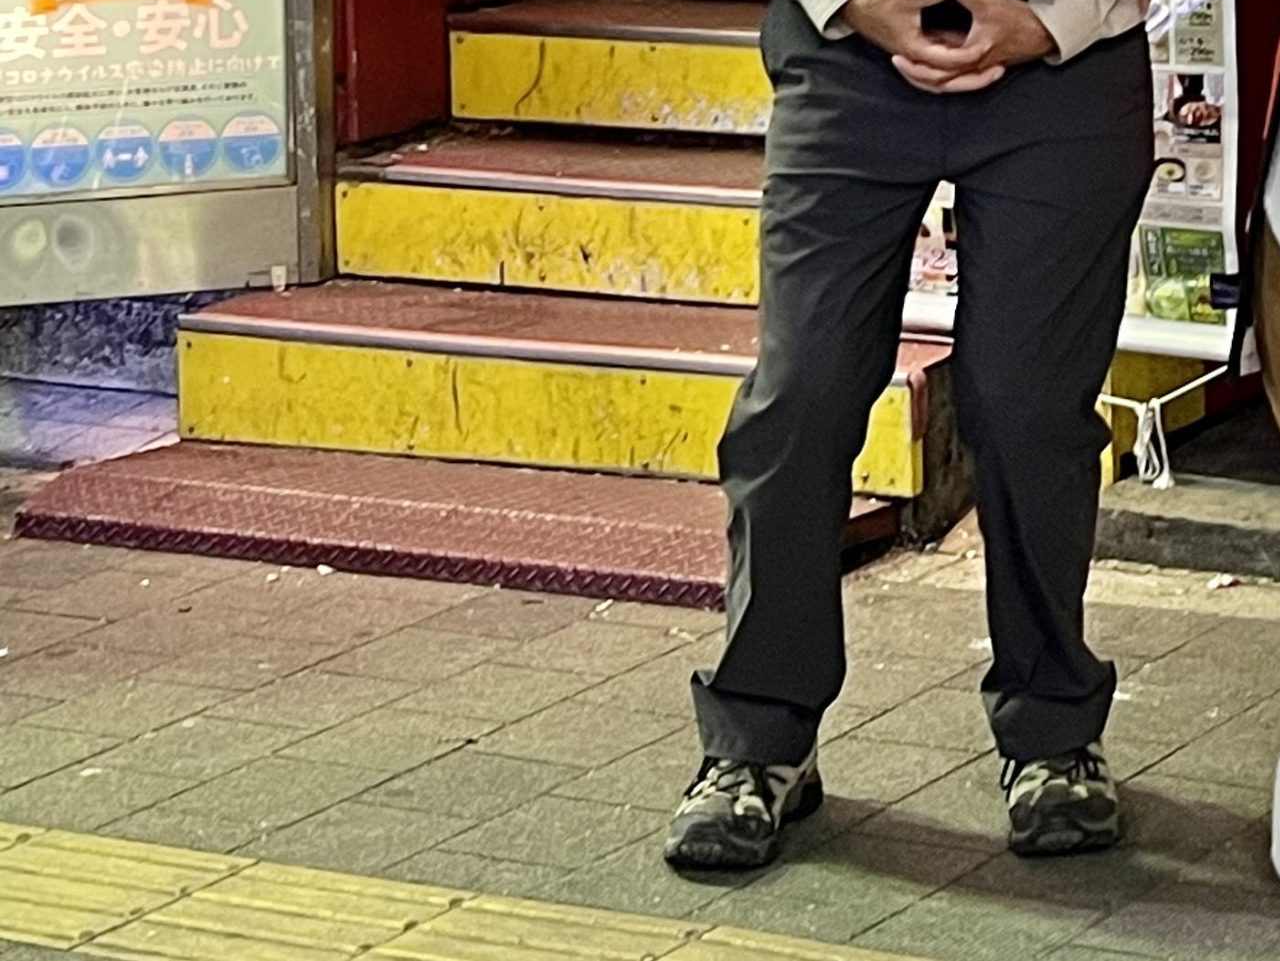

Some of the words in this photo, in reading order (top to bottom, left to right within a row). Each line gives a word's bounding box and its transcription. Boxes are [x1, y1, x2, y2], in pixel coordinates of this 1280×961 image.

[0, 54, 281, 86] コロナウイルス感染防止に向けて
